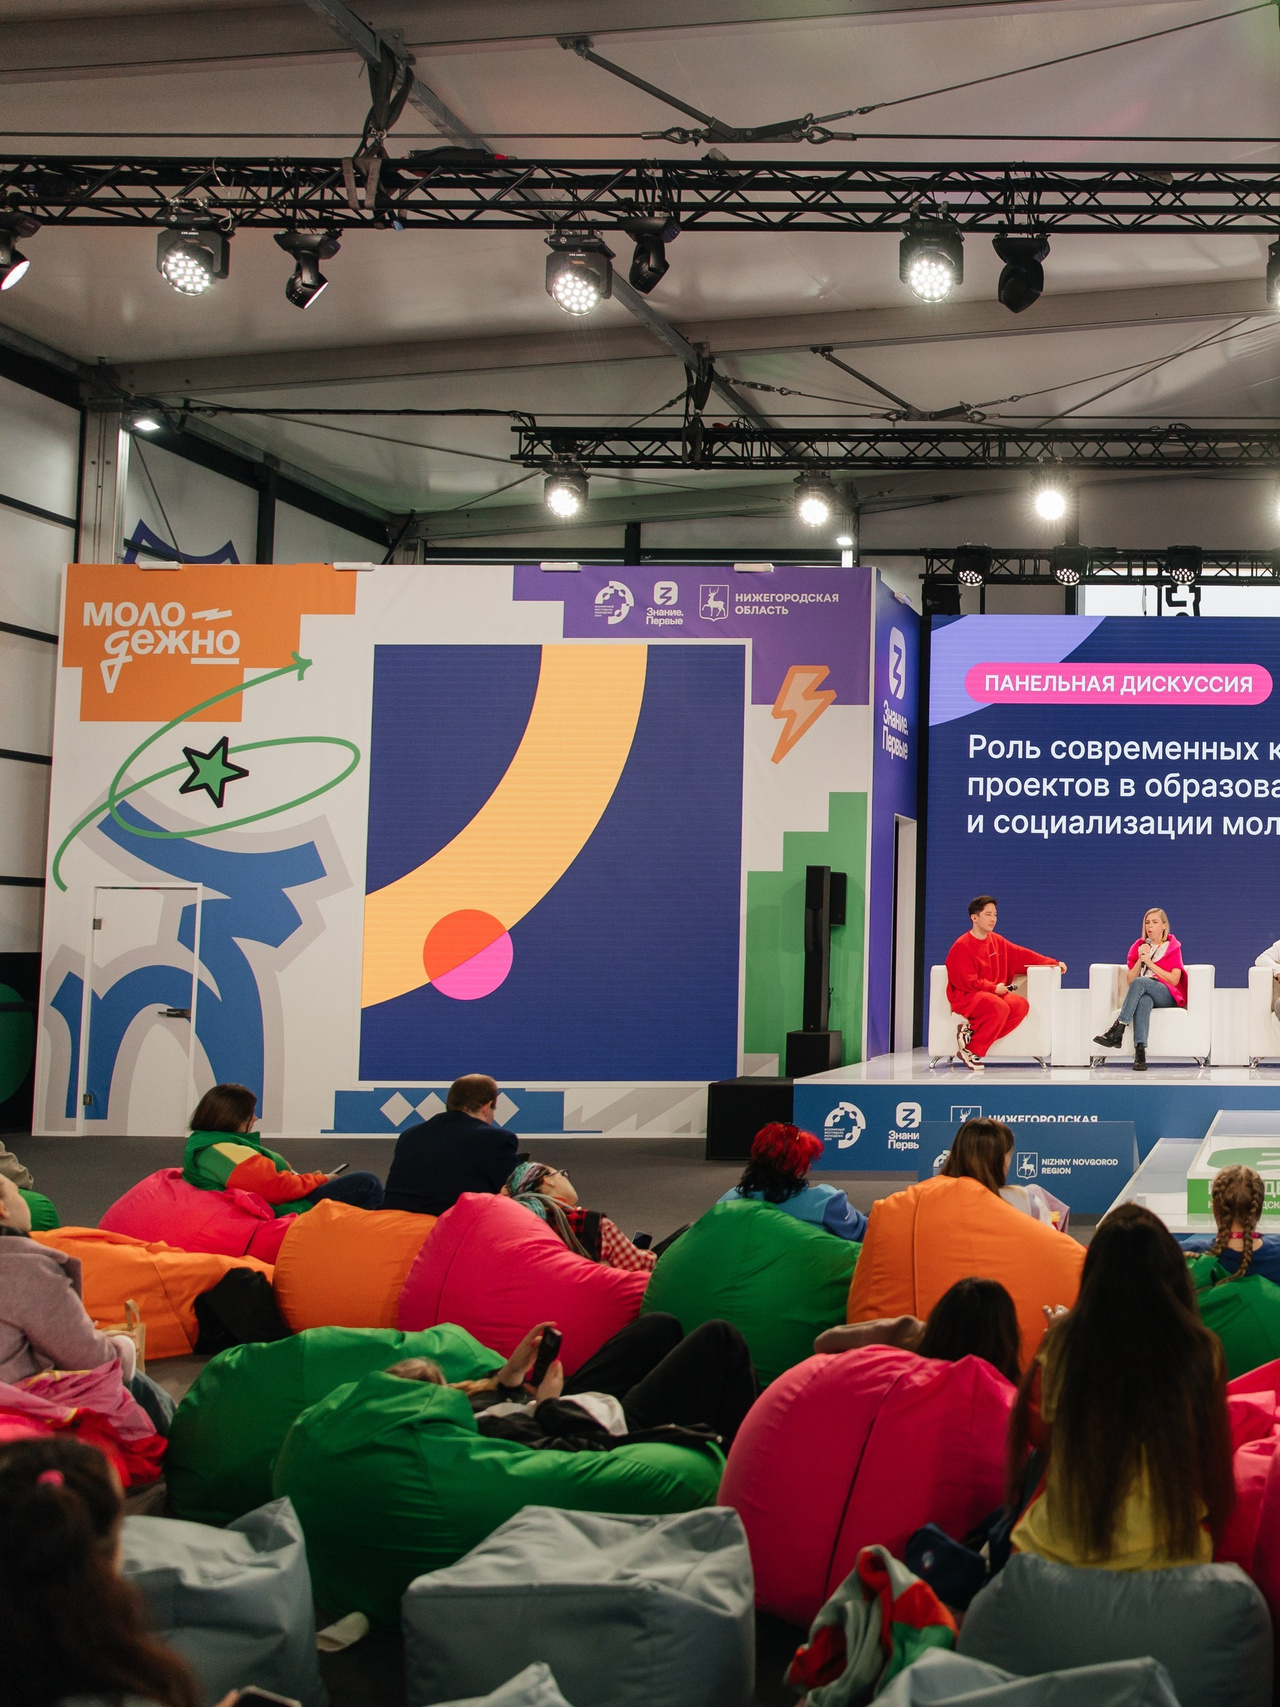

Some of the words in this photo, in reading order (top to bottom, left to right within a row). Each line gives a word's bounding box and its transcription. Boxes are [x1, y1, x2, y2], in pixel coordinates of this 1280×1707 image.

[735, 593, 839, 604] НИЖЕГОРОДСКАЯ
[735, 605, 789, 615] ОБЛАСТЬ
[645, 616, 684, 627] Первые
[985, 674, 1115, 692] ПАНЕЛЬНАЯ
[1120, 675, 1253, 696] ДИСКУССИЯ
[882, 725, 909, 760] Первые
[968, 734, 1041, 760] Роль
[1050, 739, 1260, 766] современных
[968, 773, 1110, 802] проектов
[1120, 778, 1136, 797] в
[967, 814, 984, 834] и
[993, 814, 1213, 840] социализации
[1041, 1158, 1071, 1166] NIZHNY
[1041, 1167, 1071, 1175] REGION
